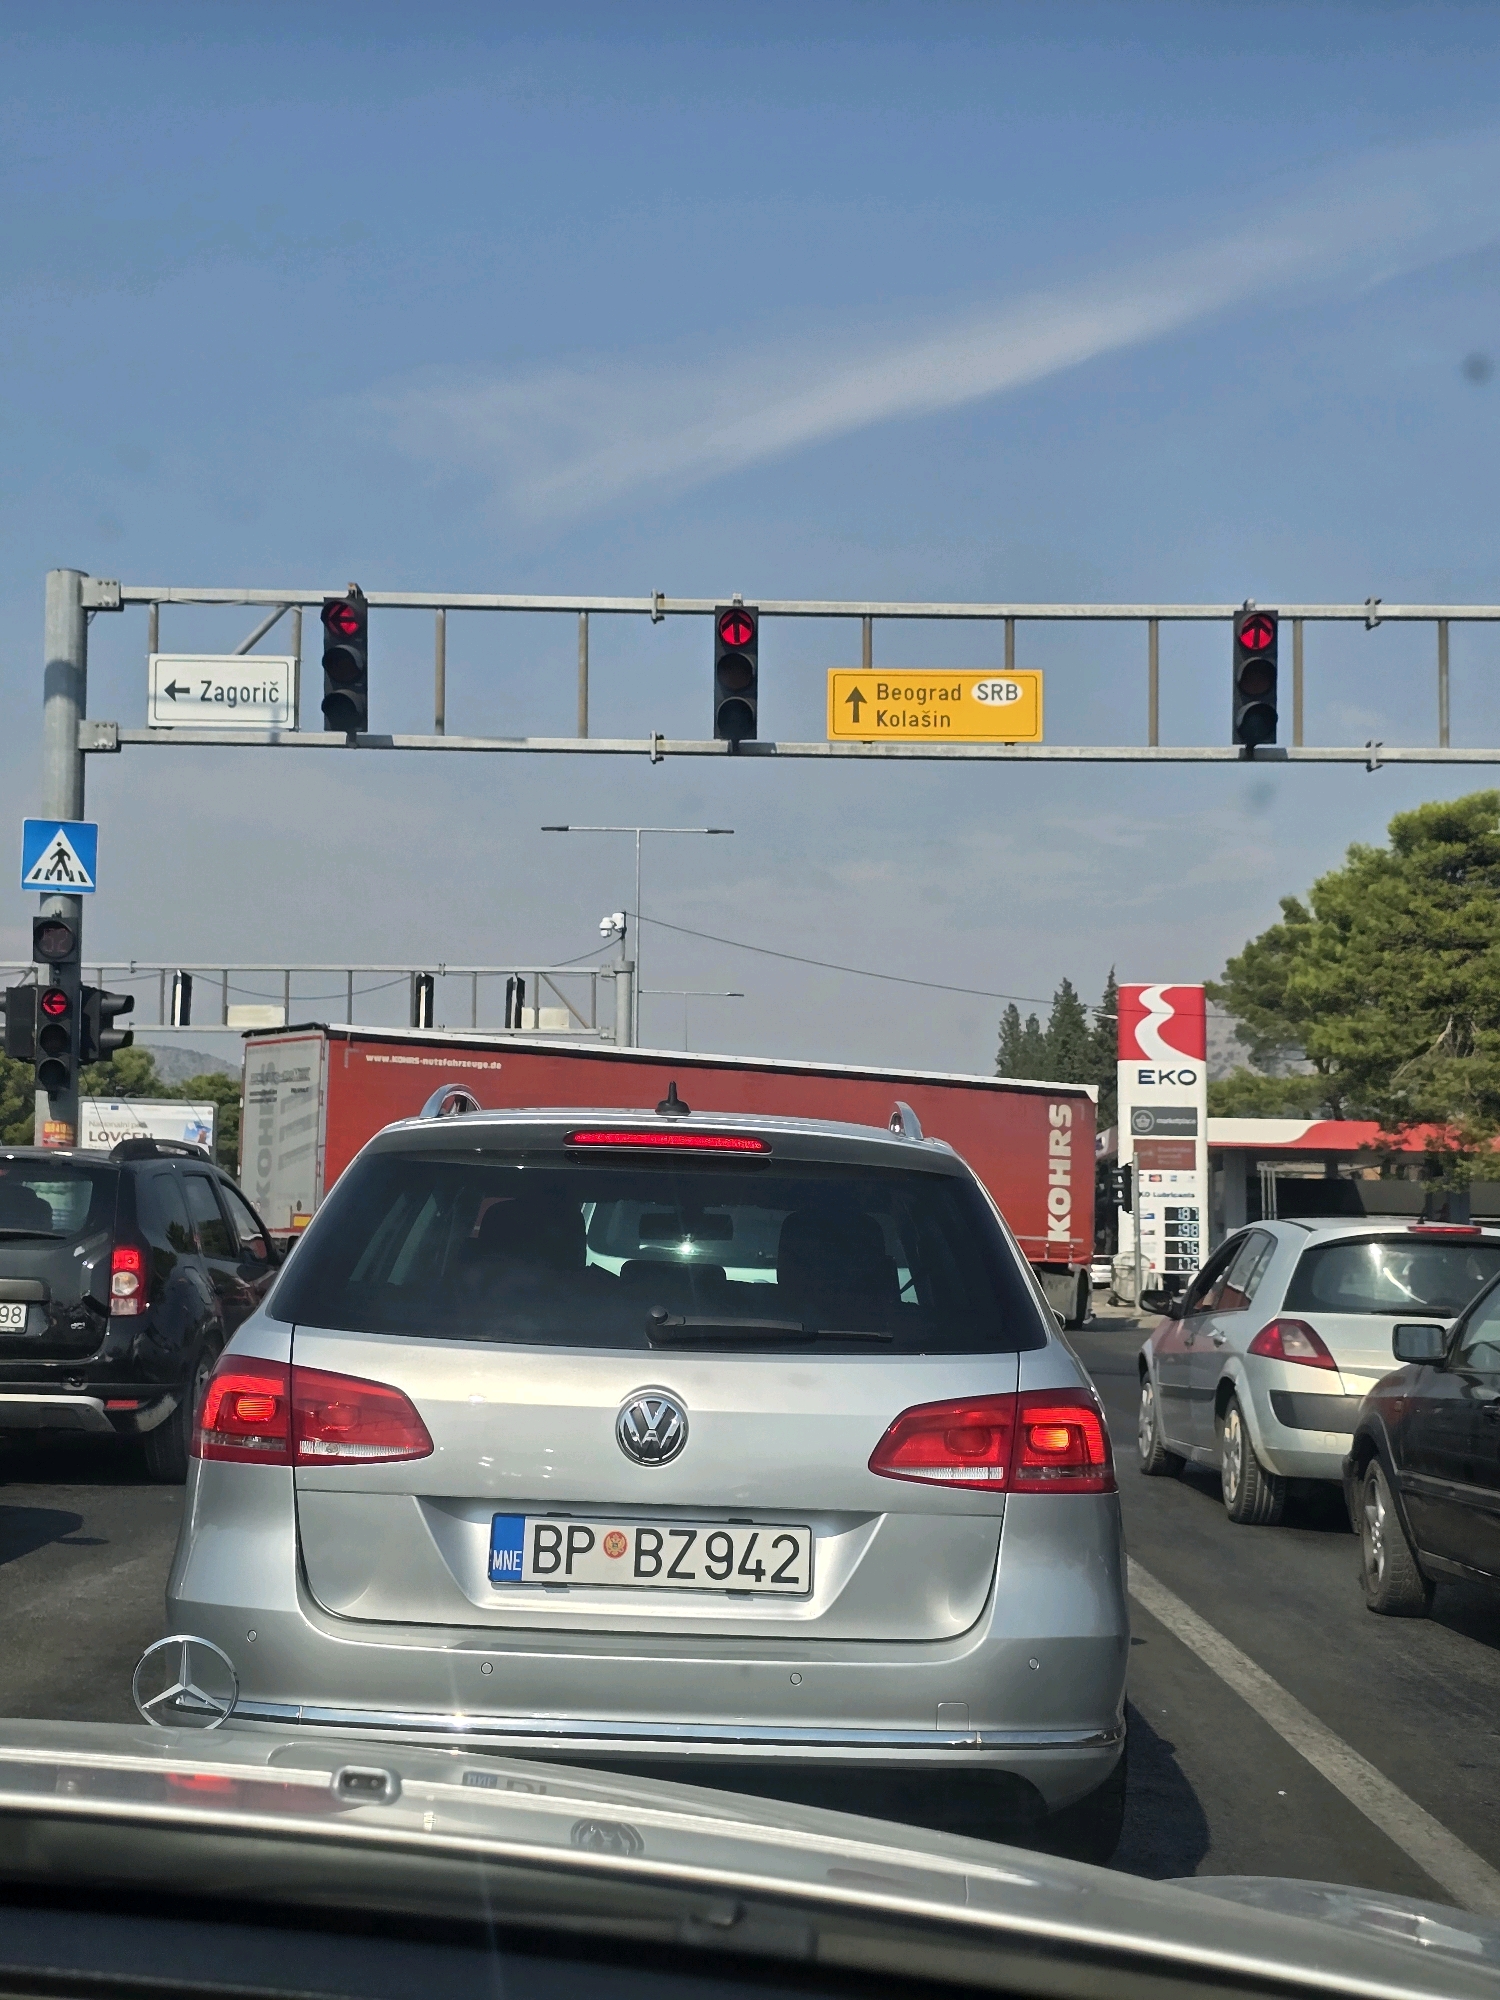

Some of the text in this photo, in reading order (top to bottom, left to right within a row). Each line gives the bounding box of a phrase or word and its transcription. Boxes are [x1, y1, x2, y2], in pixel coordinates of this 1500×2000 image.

[200, 680, 280, 708] Zagorič
[876, 683, 1019, 705] Beograd SRB
[876, 709, 951, 728] Kolašin
[1138, 1069, 1197, 1086] EKO
[1047, 1104, 1072, 1243] KOHRS
[492, 1524, 801, 1585] MNE BP BZ942
